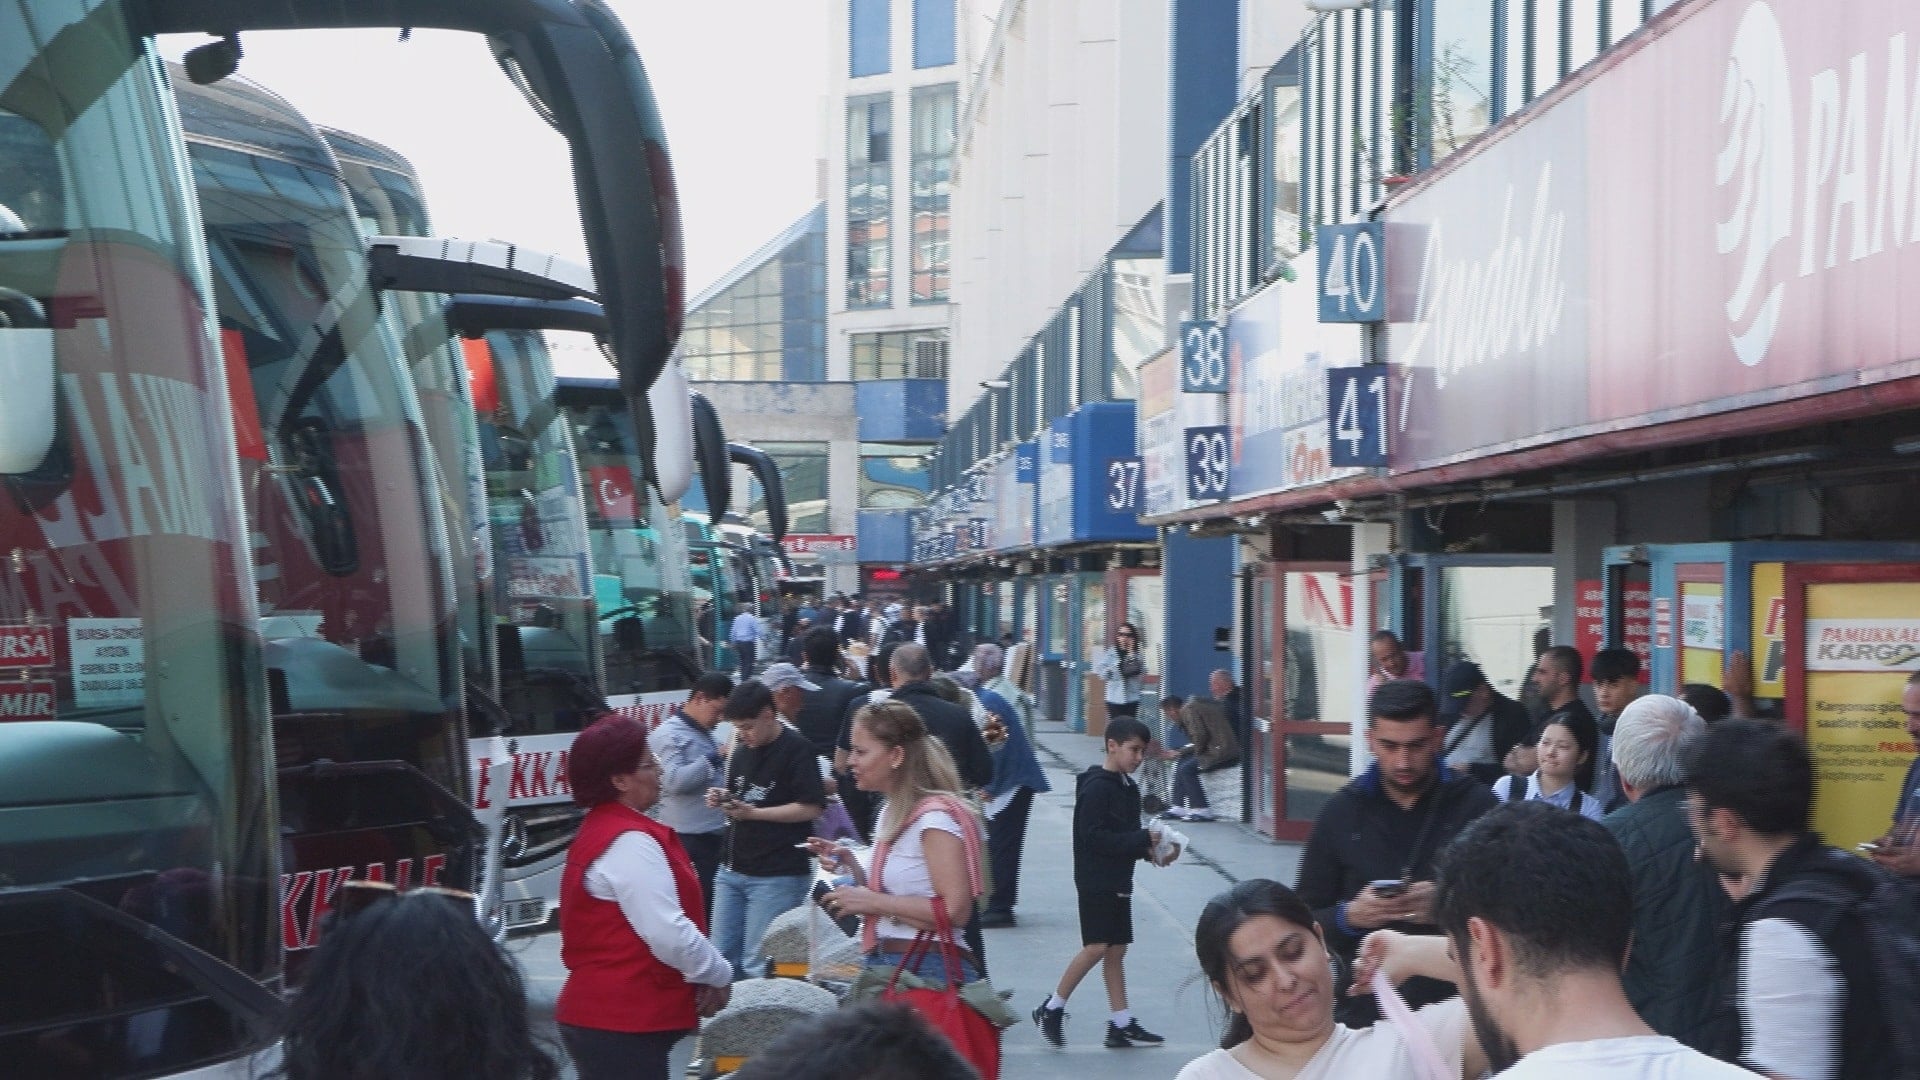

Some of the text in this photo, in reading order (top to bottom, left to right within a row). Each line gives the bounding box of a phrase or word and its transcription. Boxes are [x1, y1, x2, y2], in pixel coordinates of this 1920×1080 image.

[1324, 231, 1379, 313] 40
[1184, 326, 1225, 387] 38
[1336, 375, 1387, 457] 41
[1053, 433, 1070, 448] 36
[1018, 456, 1032, 470] 35
[1191, 433, 1228, 492] 39
[970, 474, 988, 501] 30
[1108, 461, 1141, 510] 37
[954, 488, 969, 512] 28
[941, 534, 954, 557] 27
[969, 520, 988, 547] 31
[0, 634, 49, 659] RSA
[1816, 643, 1915, 661] KARGO
[1816, 700, 1877, 715] Kargonuz
[1816, 717, 1859, 730] saatler
[1861, 717, 1901, 732] içinde
